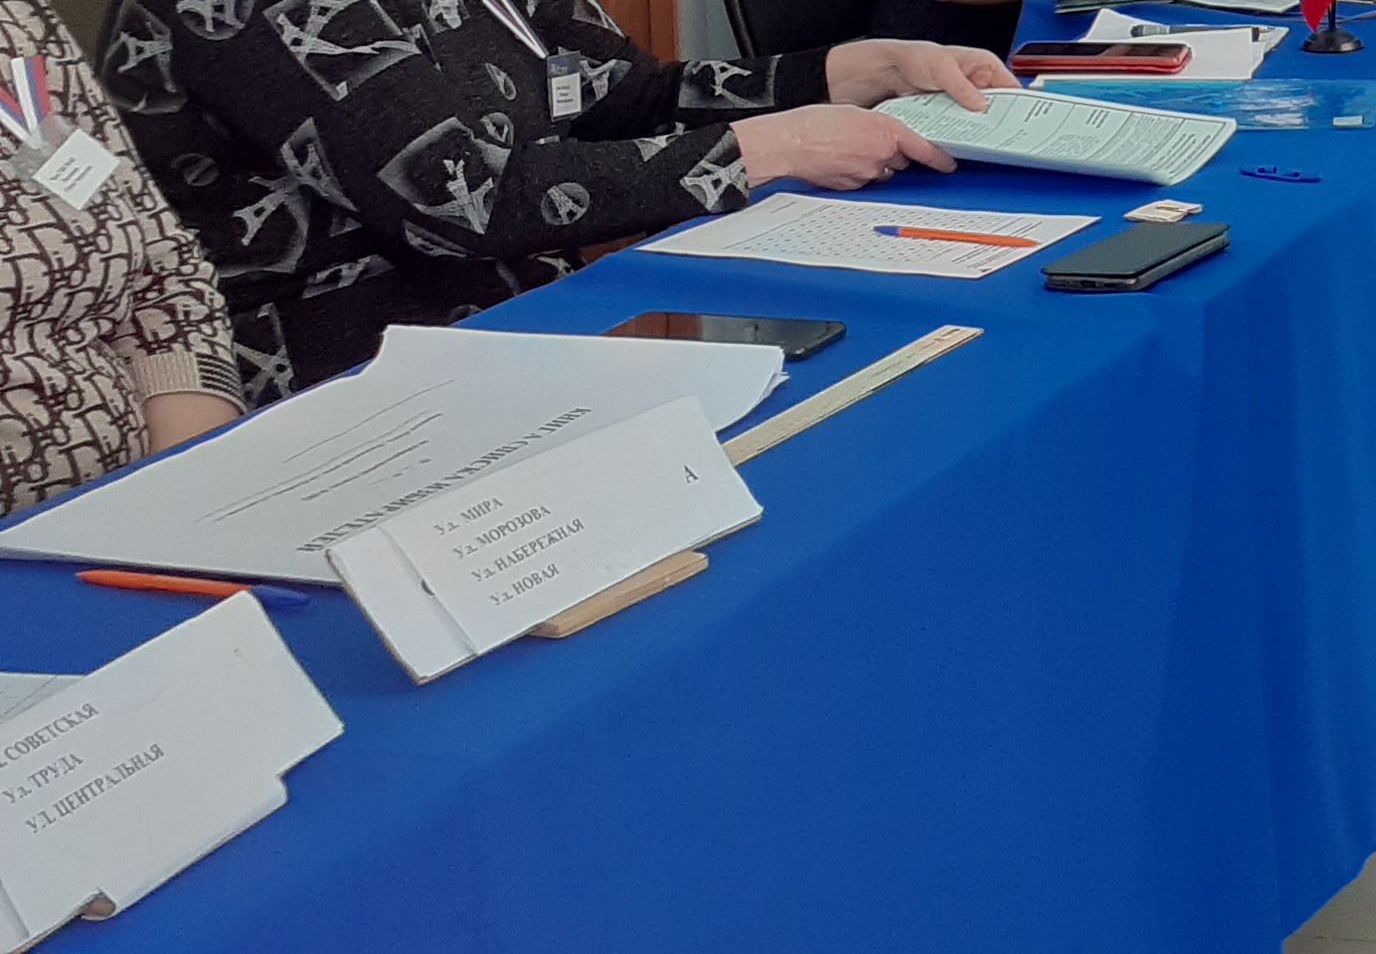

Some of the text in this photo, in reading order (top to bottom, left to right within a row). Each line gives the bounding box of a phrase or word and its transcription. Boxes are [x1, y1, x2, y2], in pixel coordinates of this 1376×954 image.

[524, 407, 592, 440] КНИГА
[460, 497, 504, 525] МИРА
[477, 505, 551, 548] МОРОЗОВА
[495, 518, 585, 571] НАБЕРЕЖНАЯ
[512, 563, 560, 595] НОВАЯ
[4, 703, 99, 761] СОВЕТСКАЯ
[28, 753, 84, 788] ТРУДА
[53, 744, 165, 818] ЦЕНТРАЛЬНАЯ
